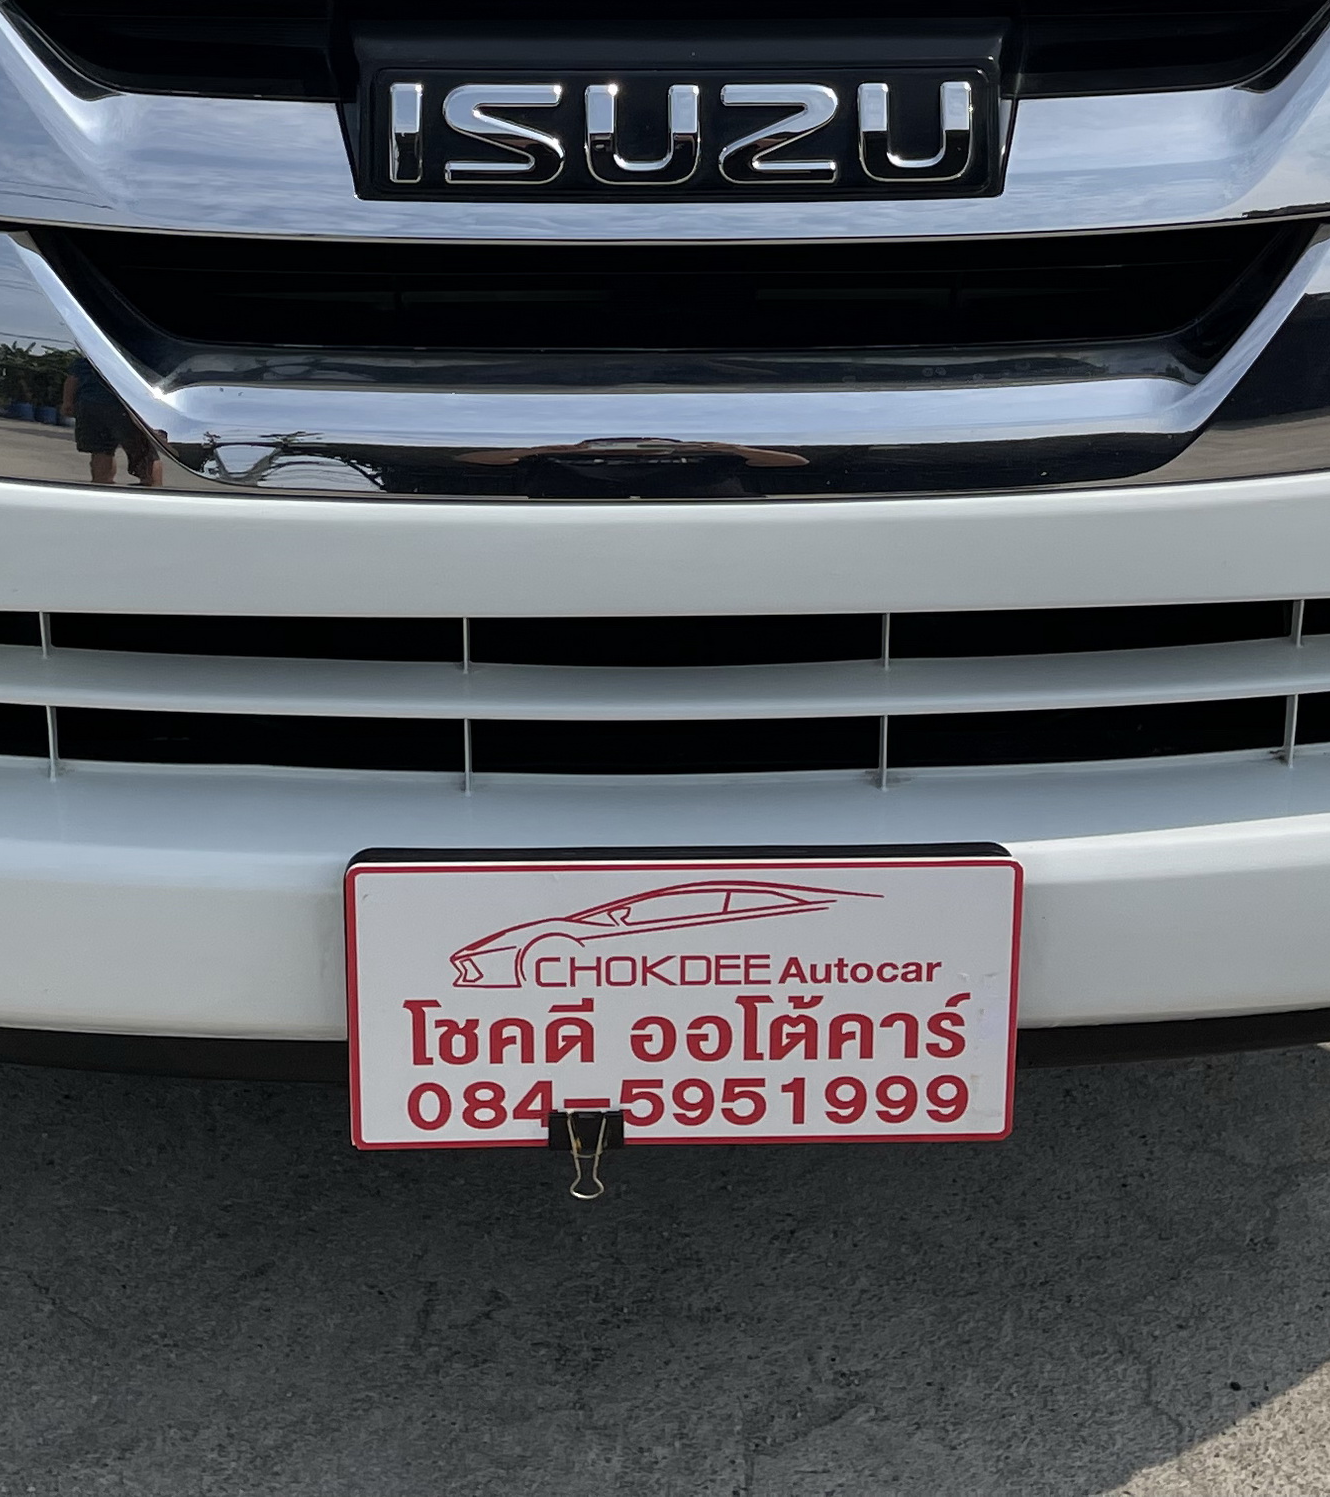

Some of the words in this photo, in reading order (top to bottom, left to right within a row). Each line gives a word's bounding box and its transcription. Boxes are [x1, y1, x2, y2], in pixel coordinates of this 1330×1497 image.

[388, 81, 973, 185] ISUZU
[534, 953, 771, 987] CHOKDEE
[778, 956, 942, 984] Autocar
[402, 997, 595, 1066] โชคดี
[630, 991, 971, 1063] ออโต้คาร์
[407, 1074, 969, 1131] 084-5951999
